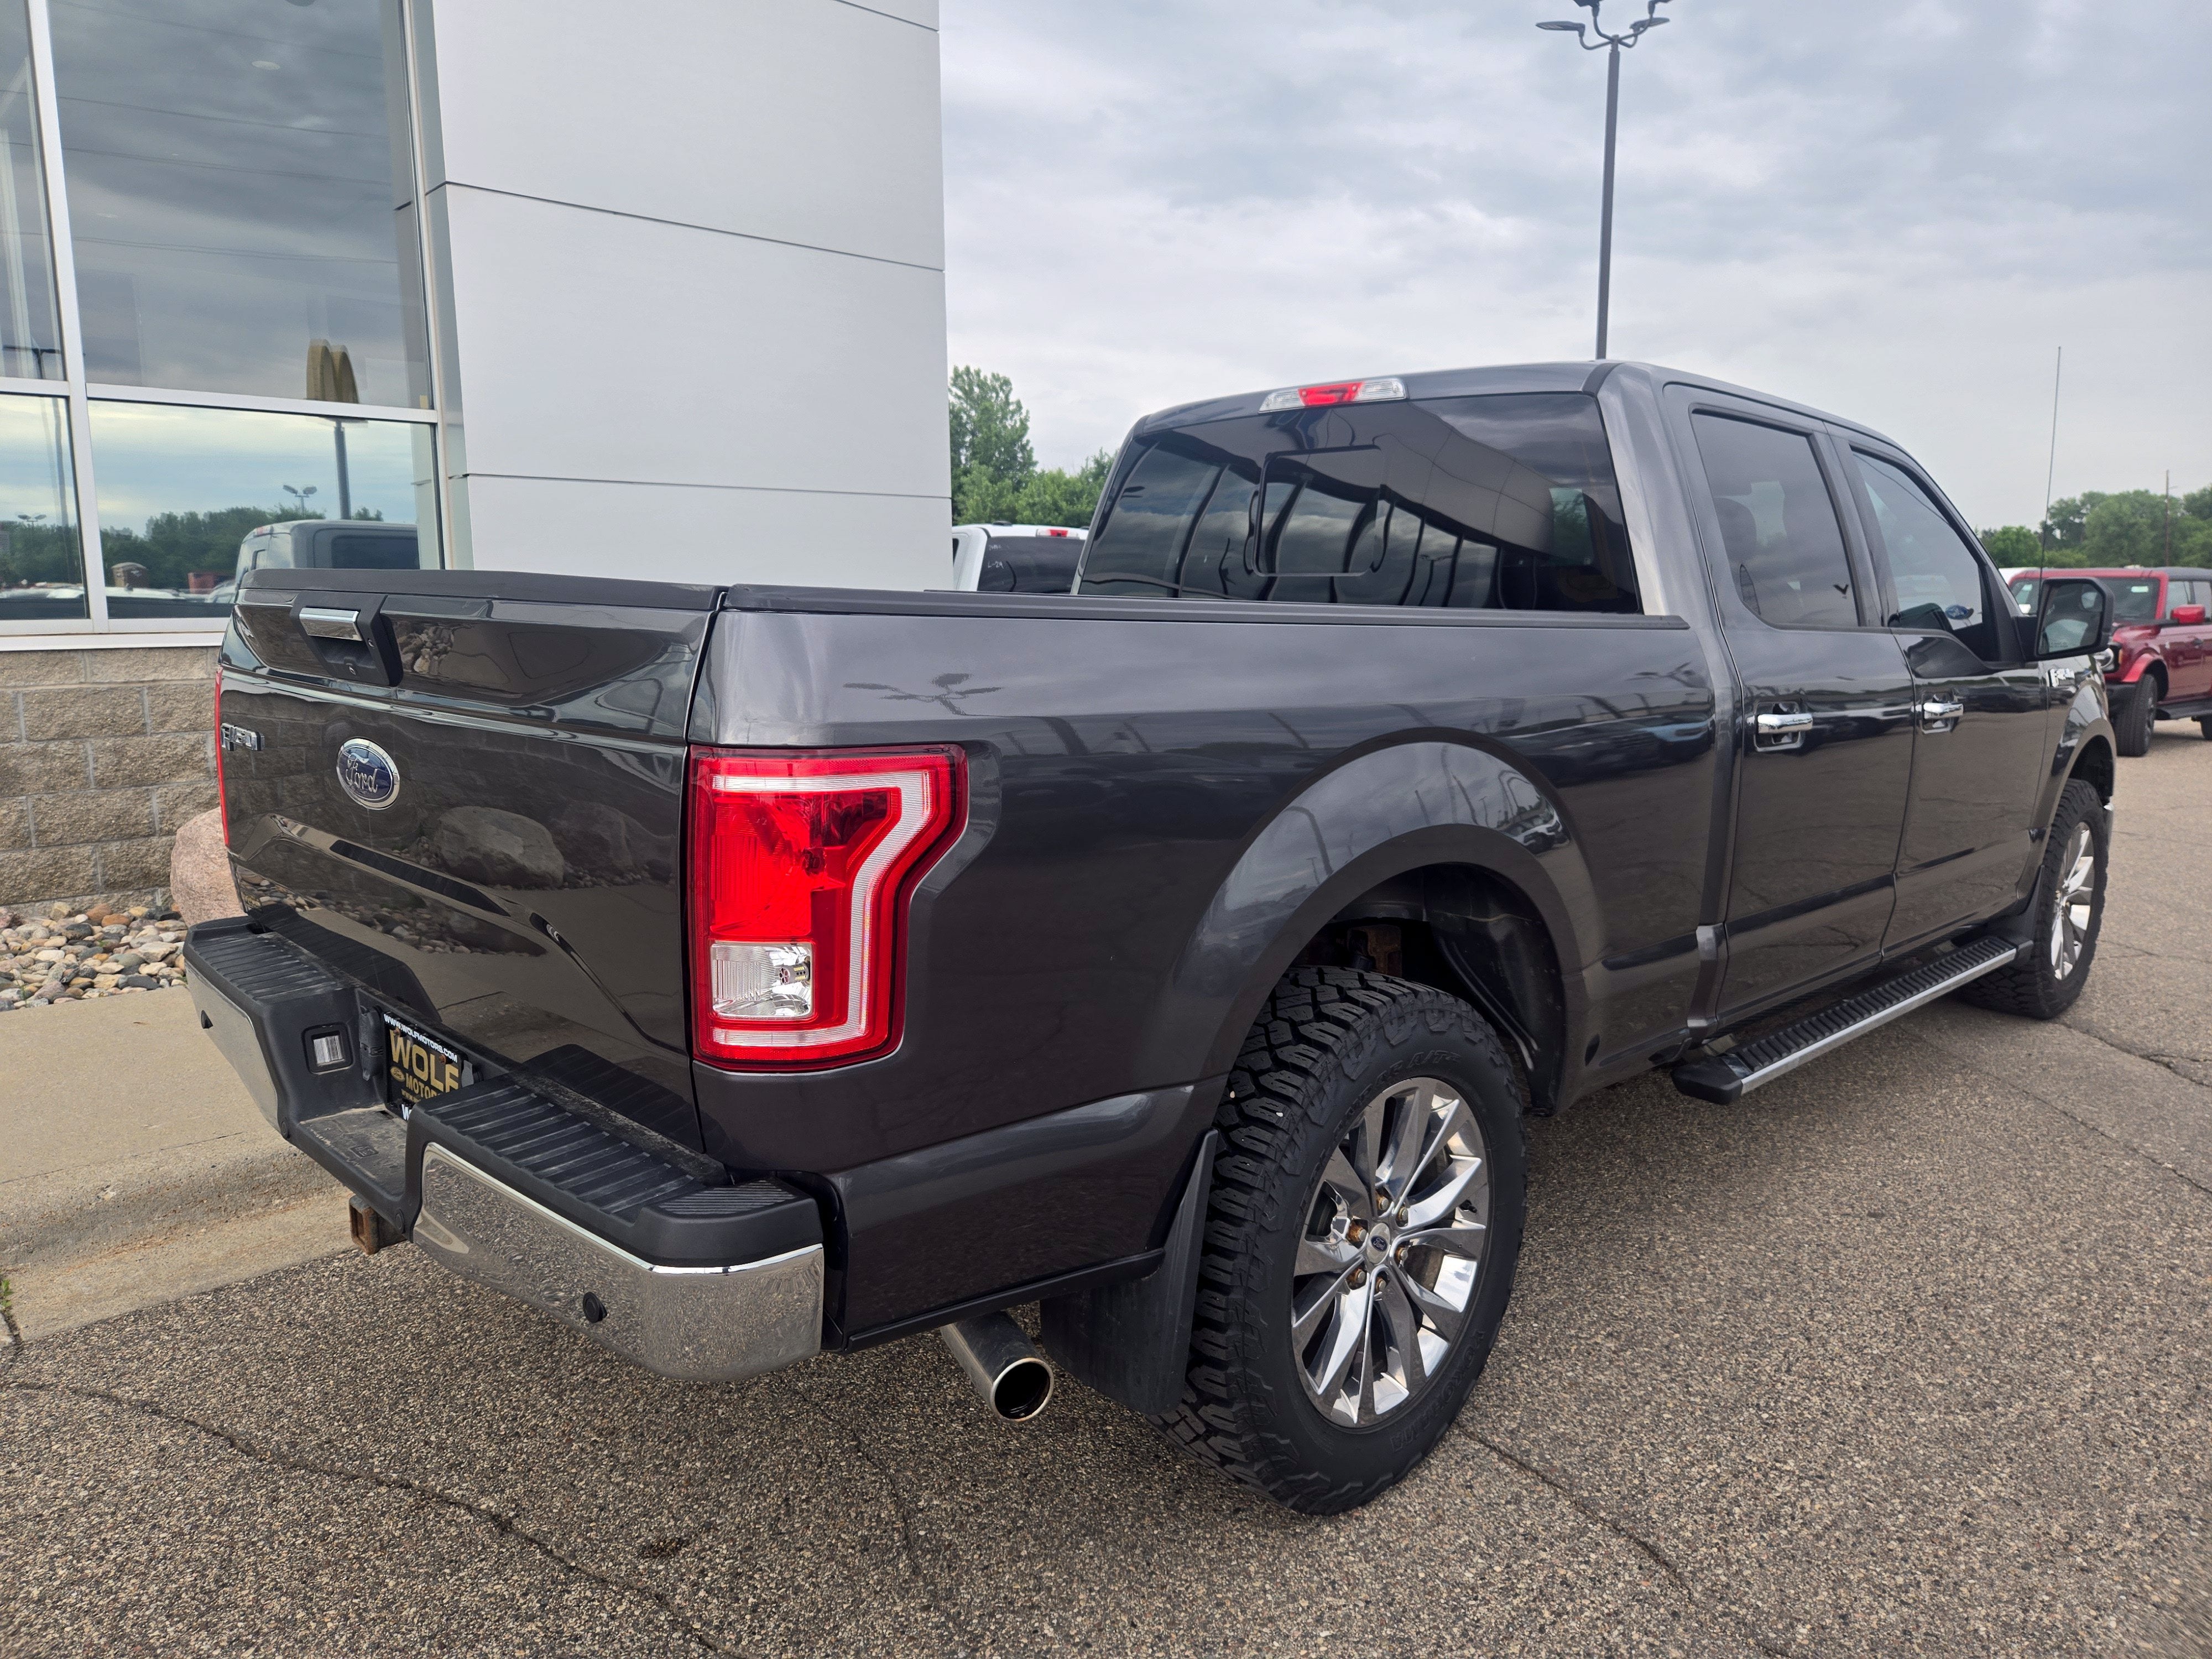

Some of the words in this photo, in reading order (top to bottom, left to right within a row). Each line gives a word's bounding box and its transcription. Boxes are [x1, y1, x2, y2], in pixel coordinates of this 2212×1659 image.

[346, 752, 378, 793] Ford
[389, 1029, 459, 1093] WOLF
[1390, 1327, 1485, 1453] YOKOHAMA
